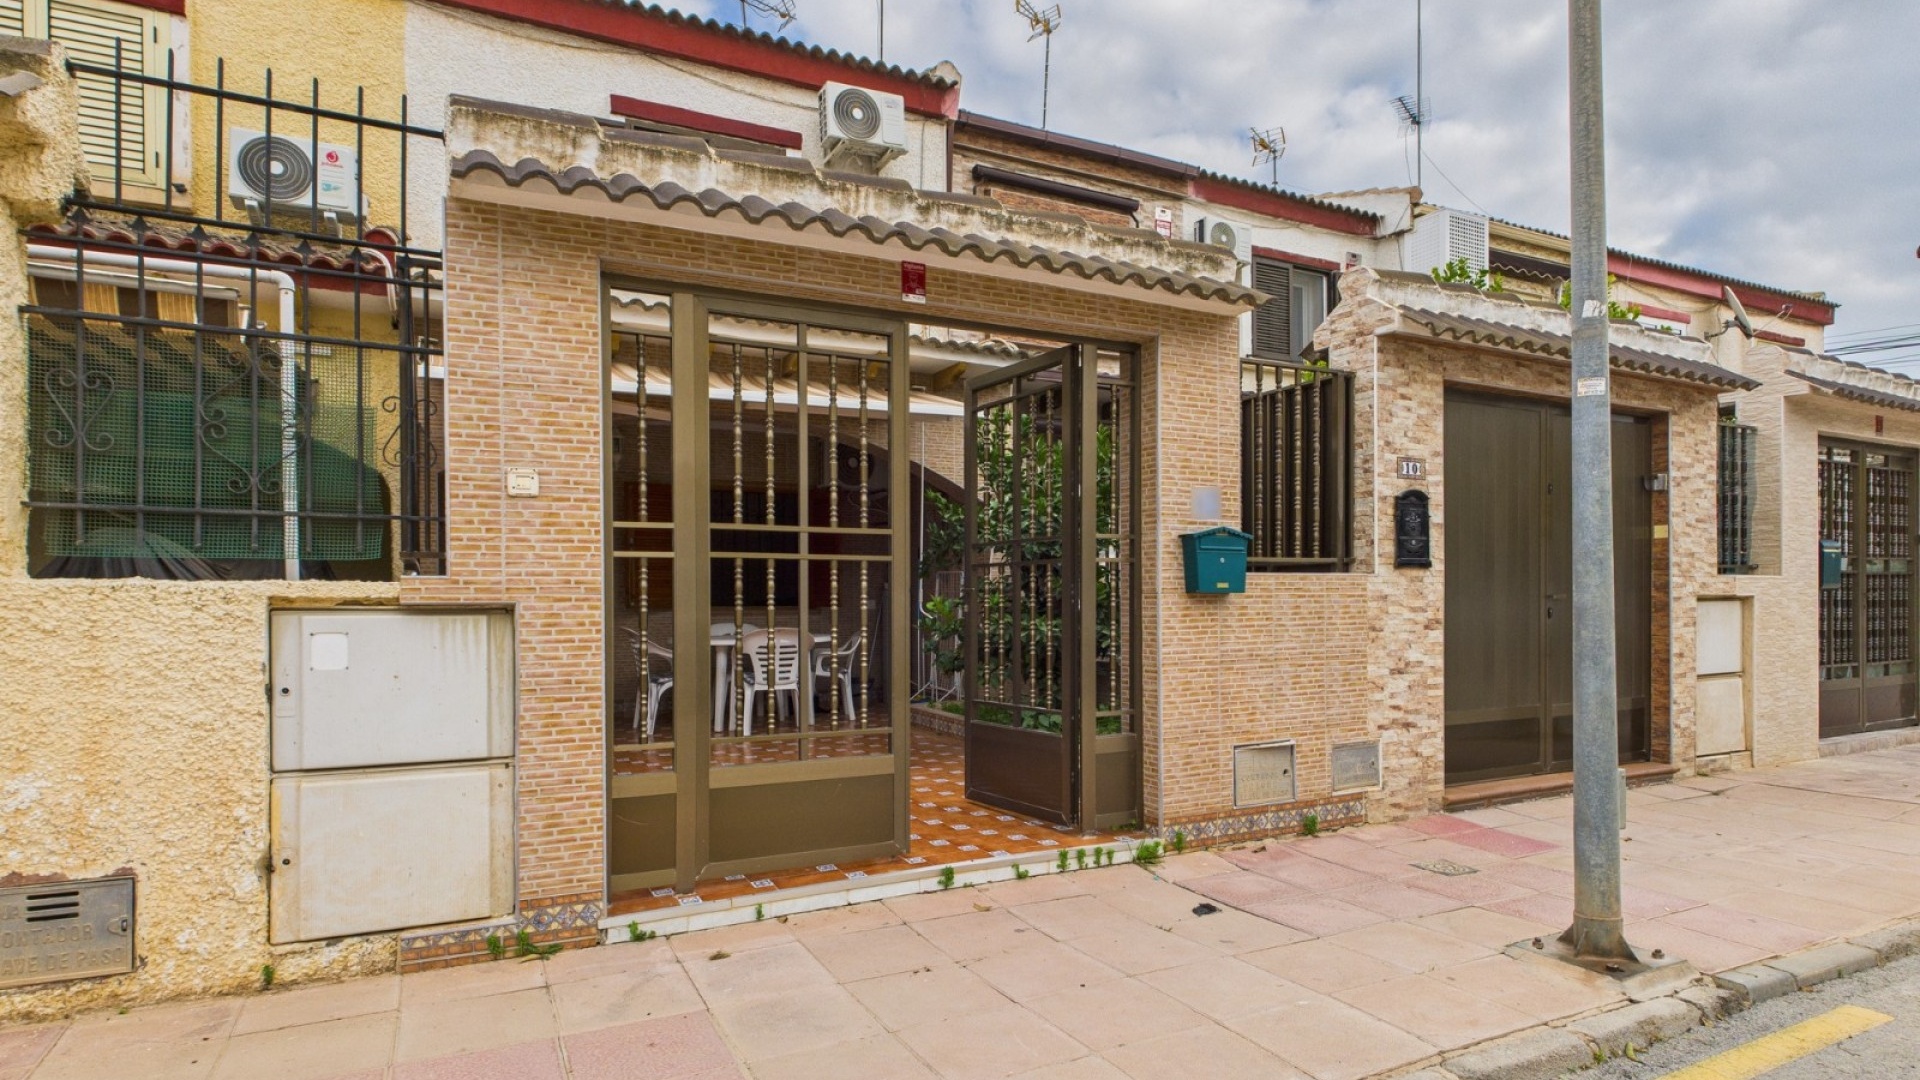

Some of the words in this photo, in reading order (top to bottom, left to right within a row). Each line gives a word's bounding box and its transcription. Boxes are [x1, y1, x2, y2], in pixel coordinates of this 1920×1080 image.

[1406, 462, 1418, 475] 10
[2, 924, 93, 949] ONTADOR
[1, 955, 39, 976] AVE
[47, 952, 70, 971] DE
[76, 948, 123, 967] PASO
